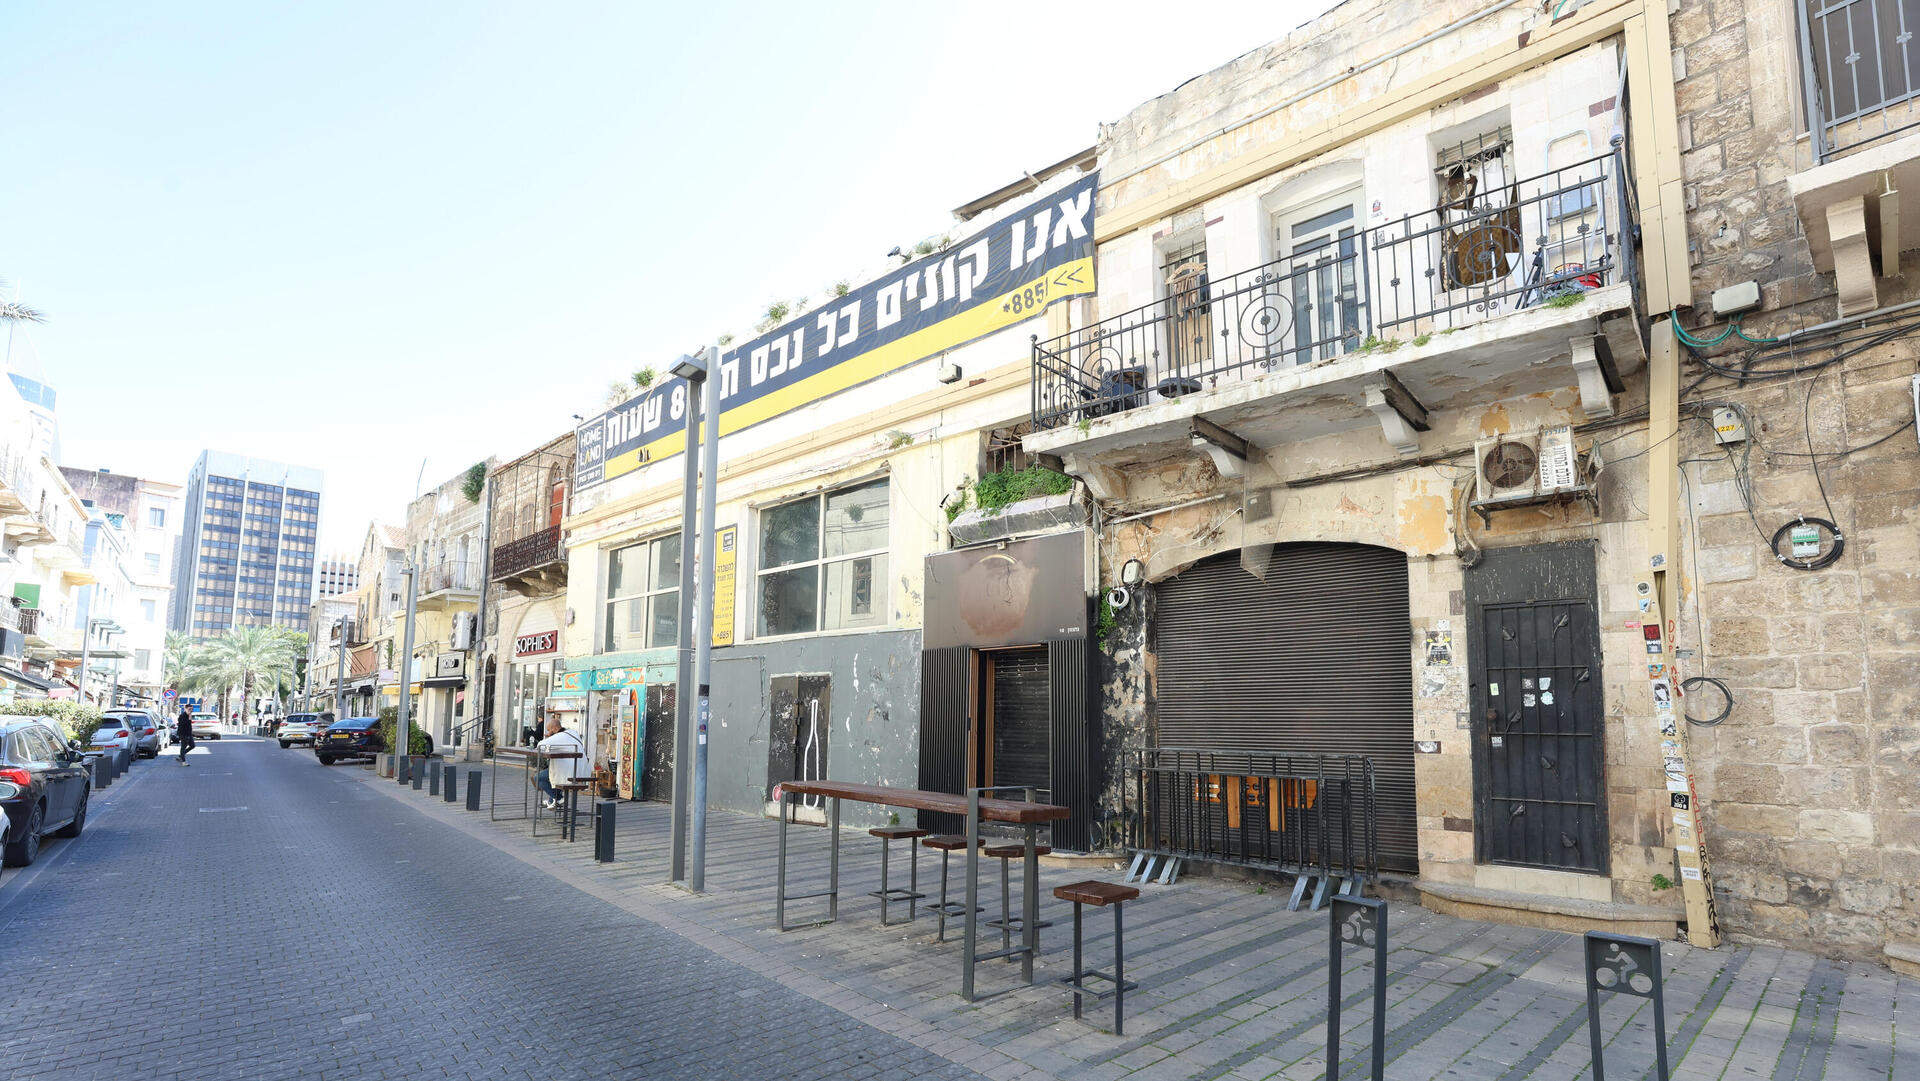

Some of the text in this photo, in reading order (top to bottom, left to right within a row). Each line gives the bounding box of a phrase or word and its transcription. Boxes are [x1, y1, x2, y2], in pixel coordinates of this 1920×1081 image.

[1010, 188, 1093, 271] אנו
[876, 237, 990, 331] קונים
[818, 300, 862, 356] כל
[750, 337, 804, 387] נכס
[606, 394, 662, 450] שעות
[670, 385, 685, 420] 8
[580, 445, 601, 465] LAND
[581, 426, 602, 448] HOME
[516, 633, 553, 653] SOPHIE'S
